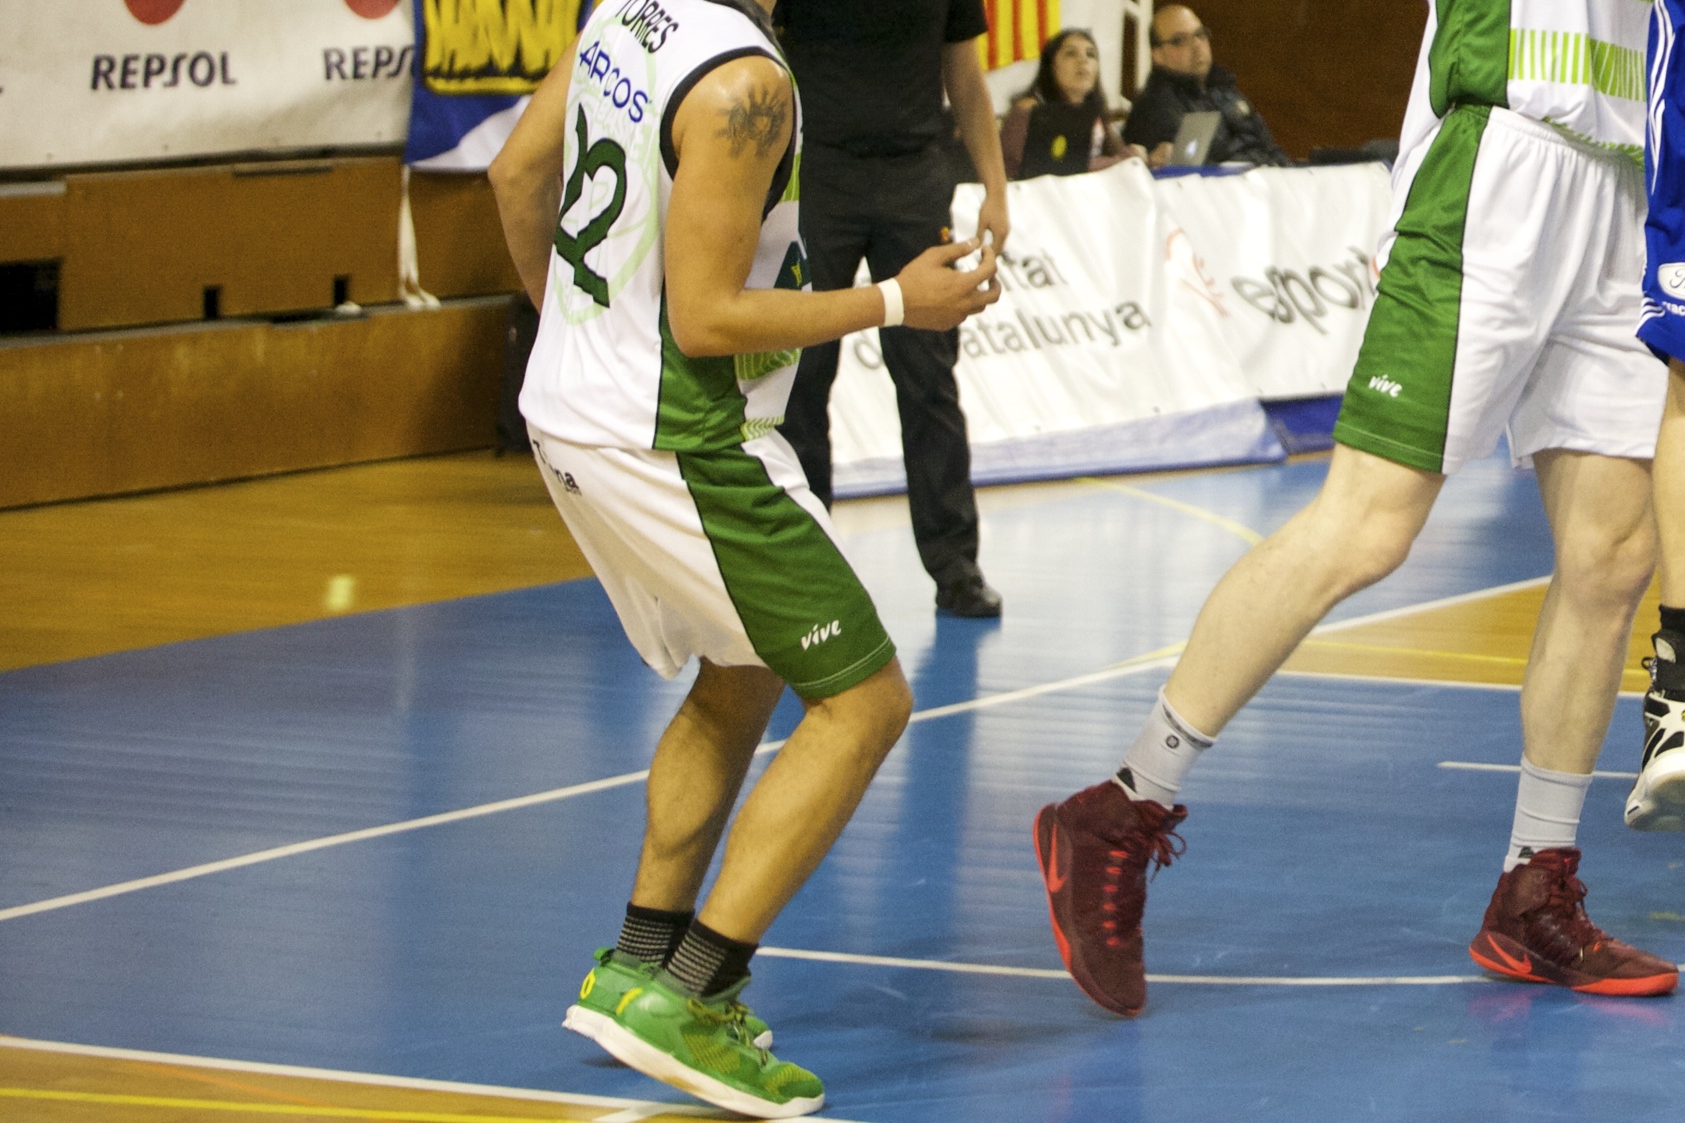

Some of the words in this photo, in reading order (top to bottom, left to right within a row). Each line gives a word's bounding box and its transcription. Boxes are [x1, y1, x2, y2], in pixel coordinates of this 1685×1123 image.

[90, 52, 237, 91] REPSOL
[323, 45, 413, 80] REPS
[579, 40, 652, 123] ARCOS
[960, 298, 1152, 359] atalunya
[801, 619, 842, 652] vive
